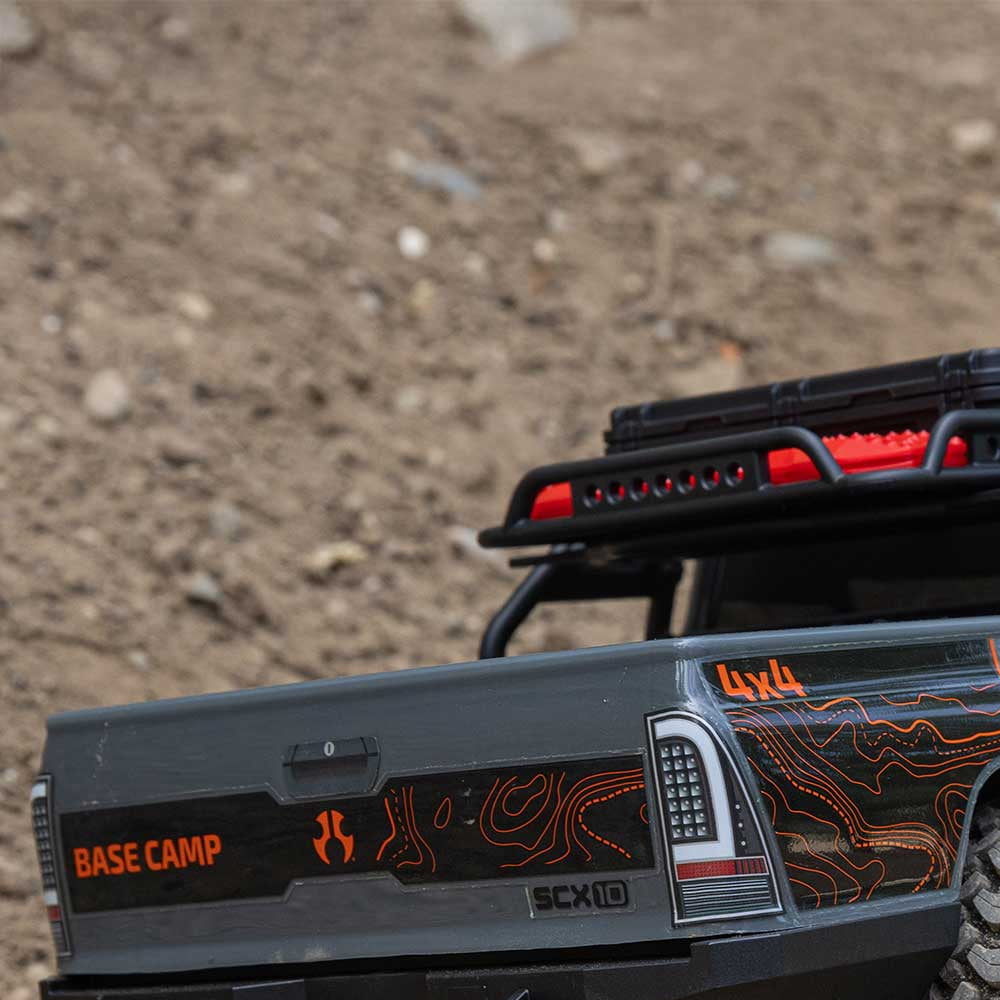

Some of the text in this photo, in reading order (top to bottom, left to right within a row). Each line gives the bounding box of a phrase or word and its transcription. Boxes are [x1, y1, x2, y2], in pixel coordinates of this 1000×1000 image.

[716, 658, 807, 702] 4x4
[73, 834, 222, 879] BASE CAMP
[532, 880, 628, 911] SCX10
